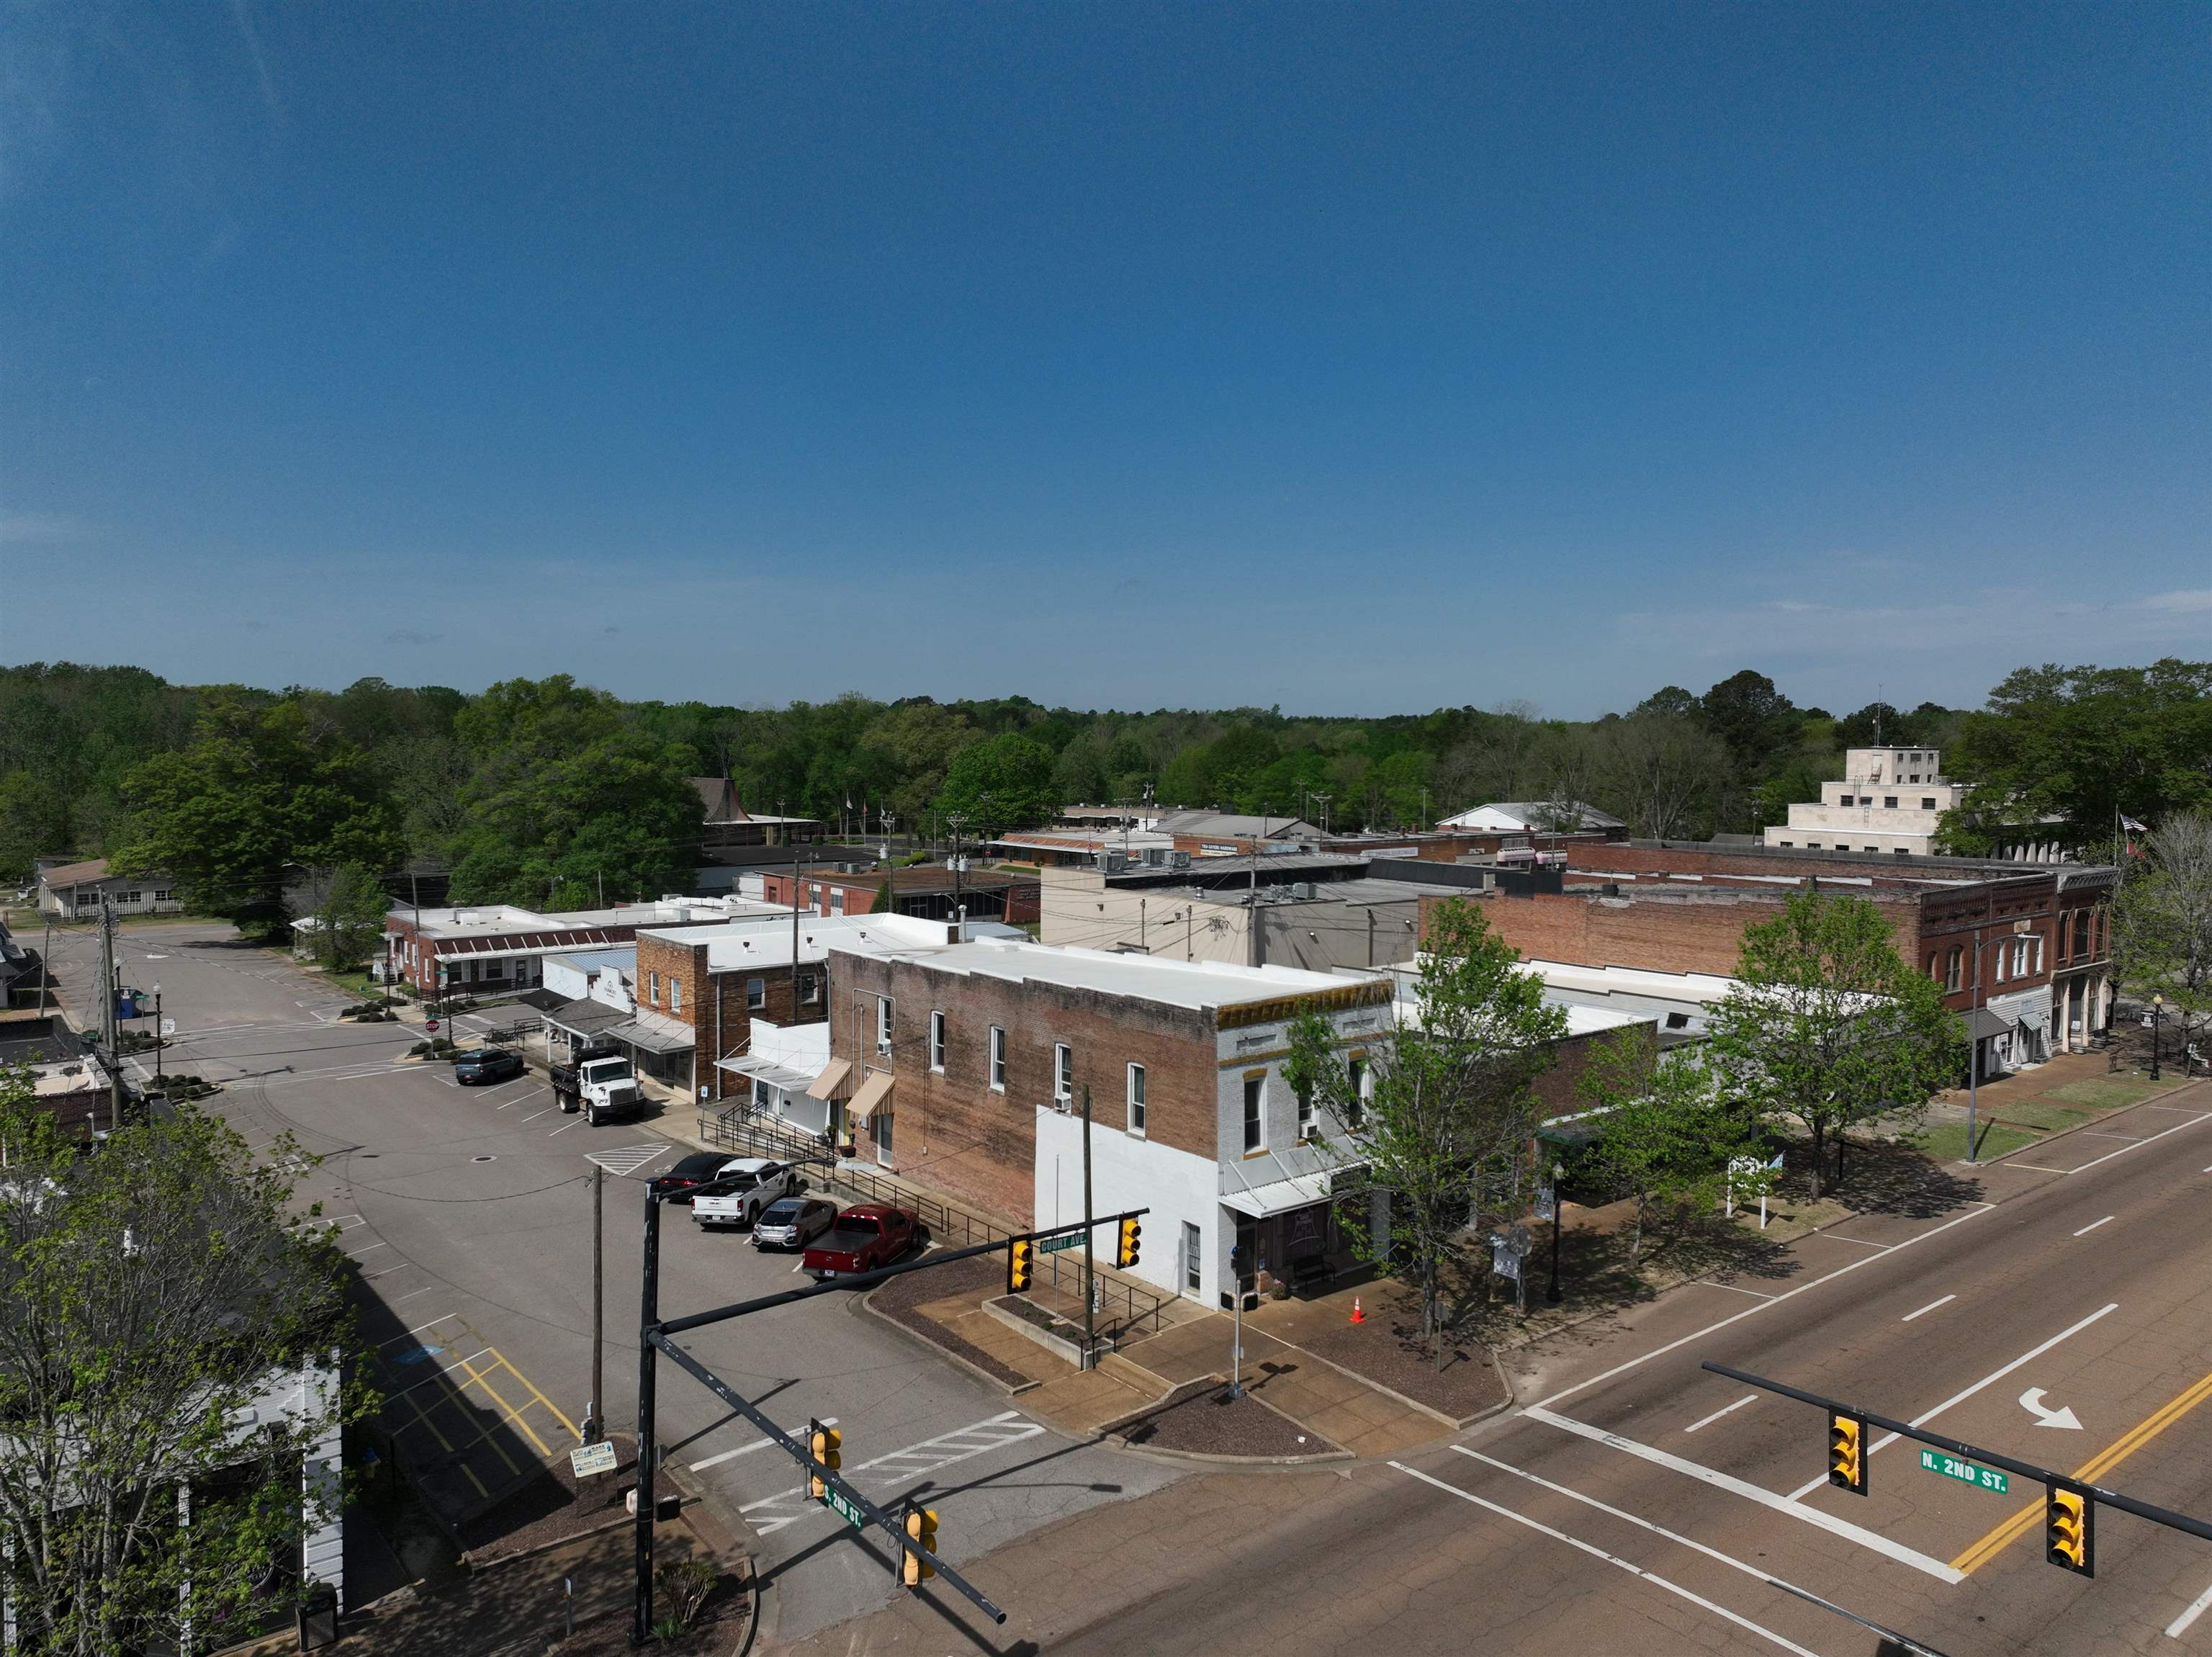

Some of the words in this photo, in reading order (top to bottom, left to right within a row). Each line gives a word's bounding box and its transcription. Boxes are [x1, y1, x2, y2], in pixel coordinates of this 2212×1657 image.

[1041, 1238, 1067, 1252] COURT
[1071, 1234, 1087, 1247] AVE.
[1923, 1451, 1938, 1470] N.
[1944, 1458, 1975, 1481] 2ND
[1982, 1470, 2006, 1491] ST.
[824, 1484, 831, 1502] S.
[833, 1492, 847, 1515] 2ND
[850, 1506, 860, 1527] ST.
